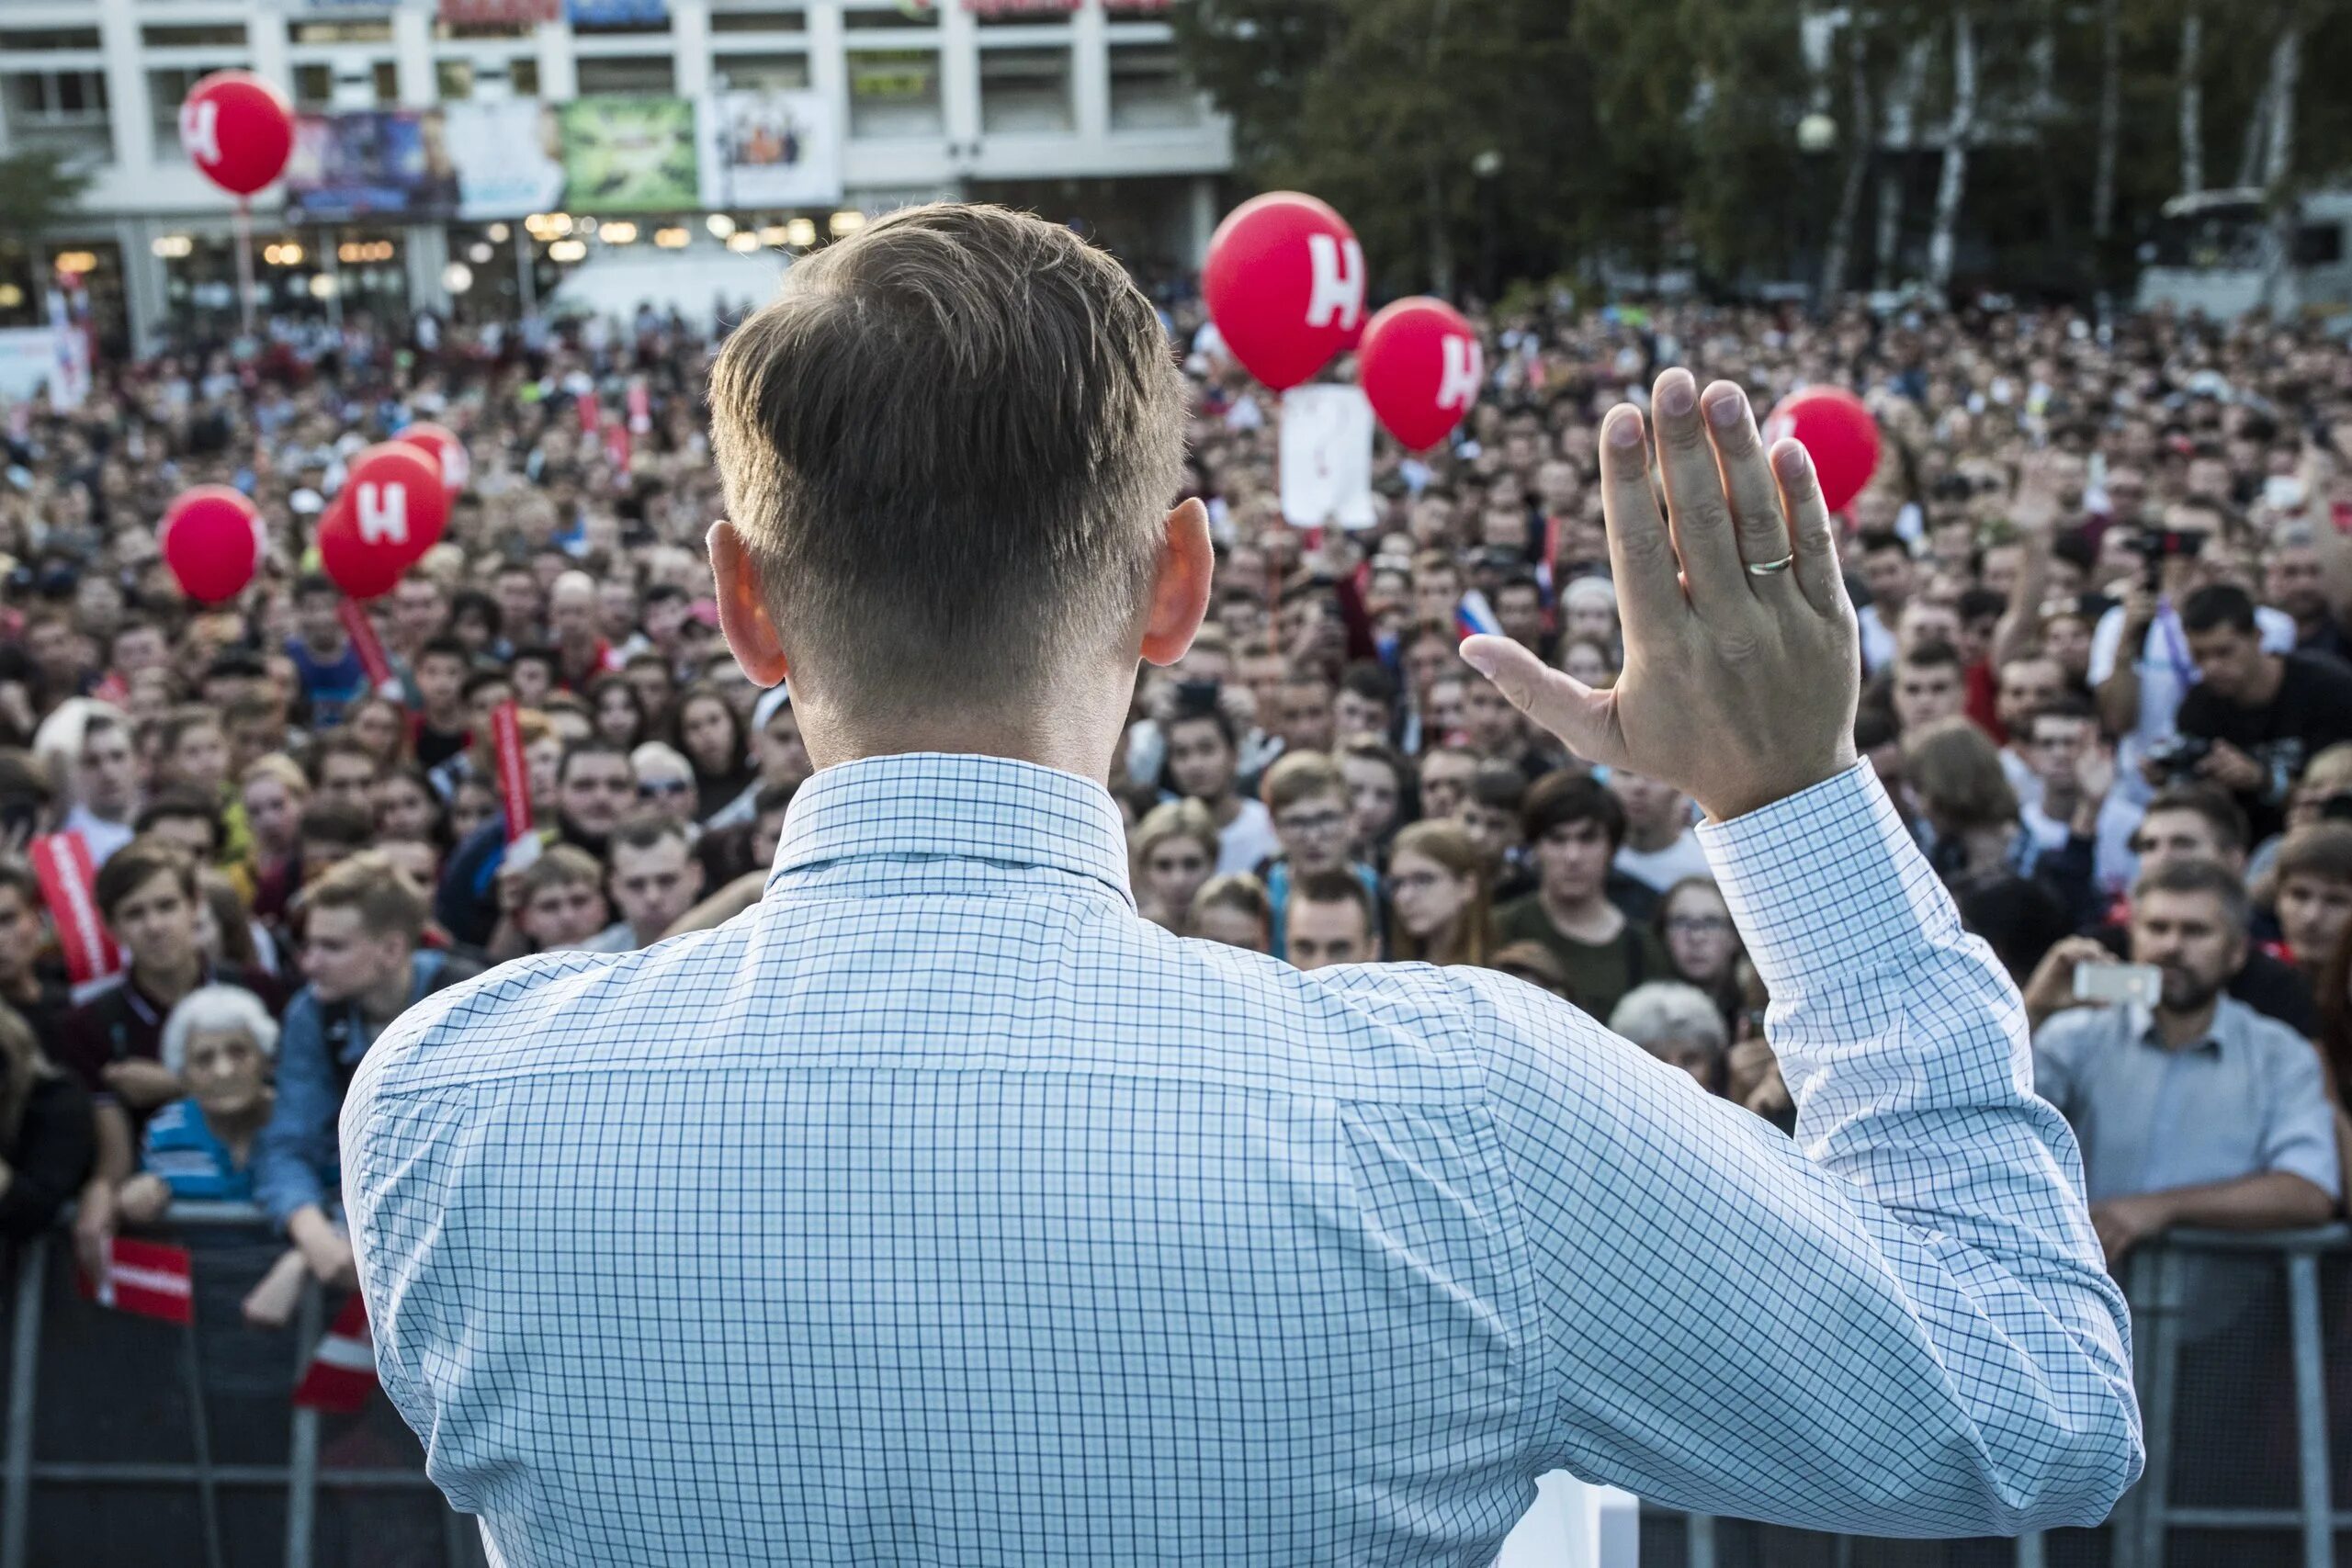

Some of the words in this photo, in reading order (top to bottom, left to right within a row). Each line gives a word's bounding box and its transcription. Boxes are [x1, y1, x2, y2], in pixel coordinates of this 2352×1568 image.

[1306, 233, 1364, 332] Н
[1436, 334, 1484, 411] Н
[356, 481, 409, 546] Н
